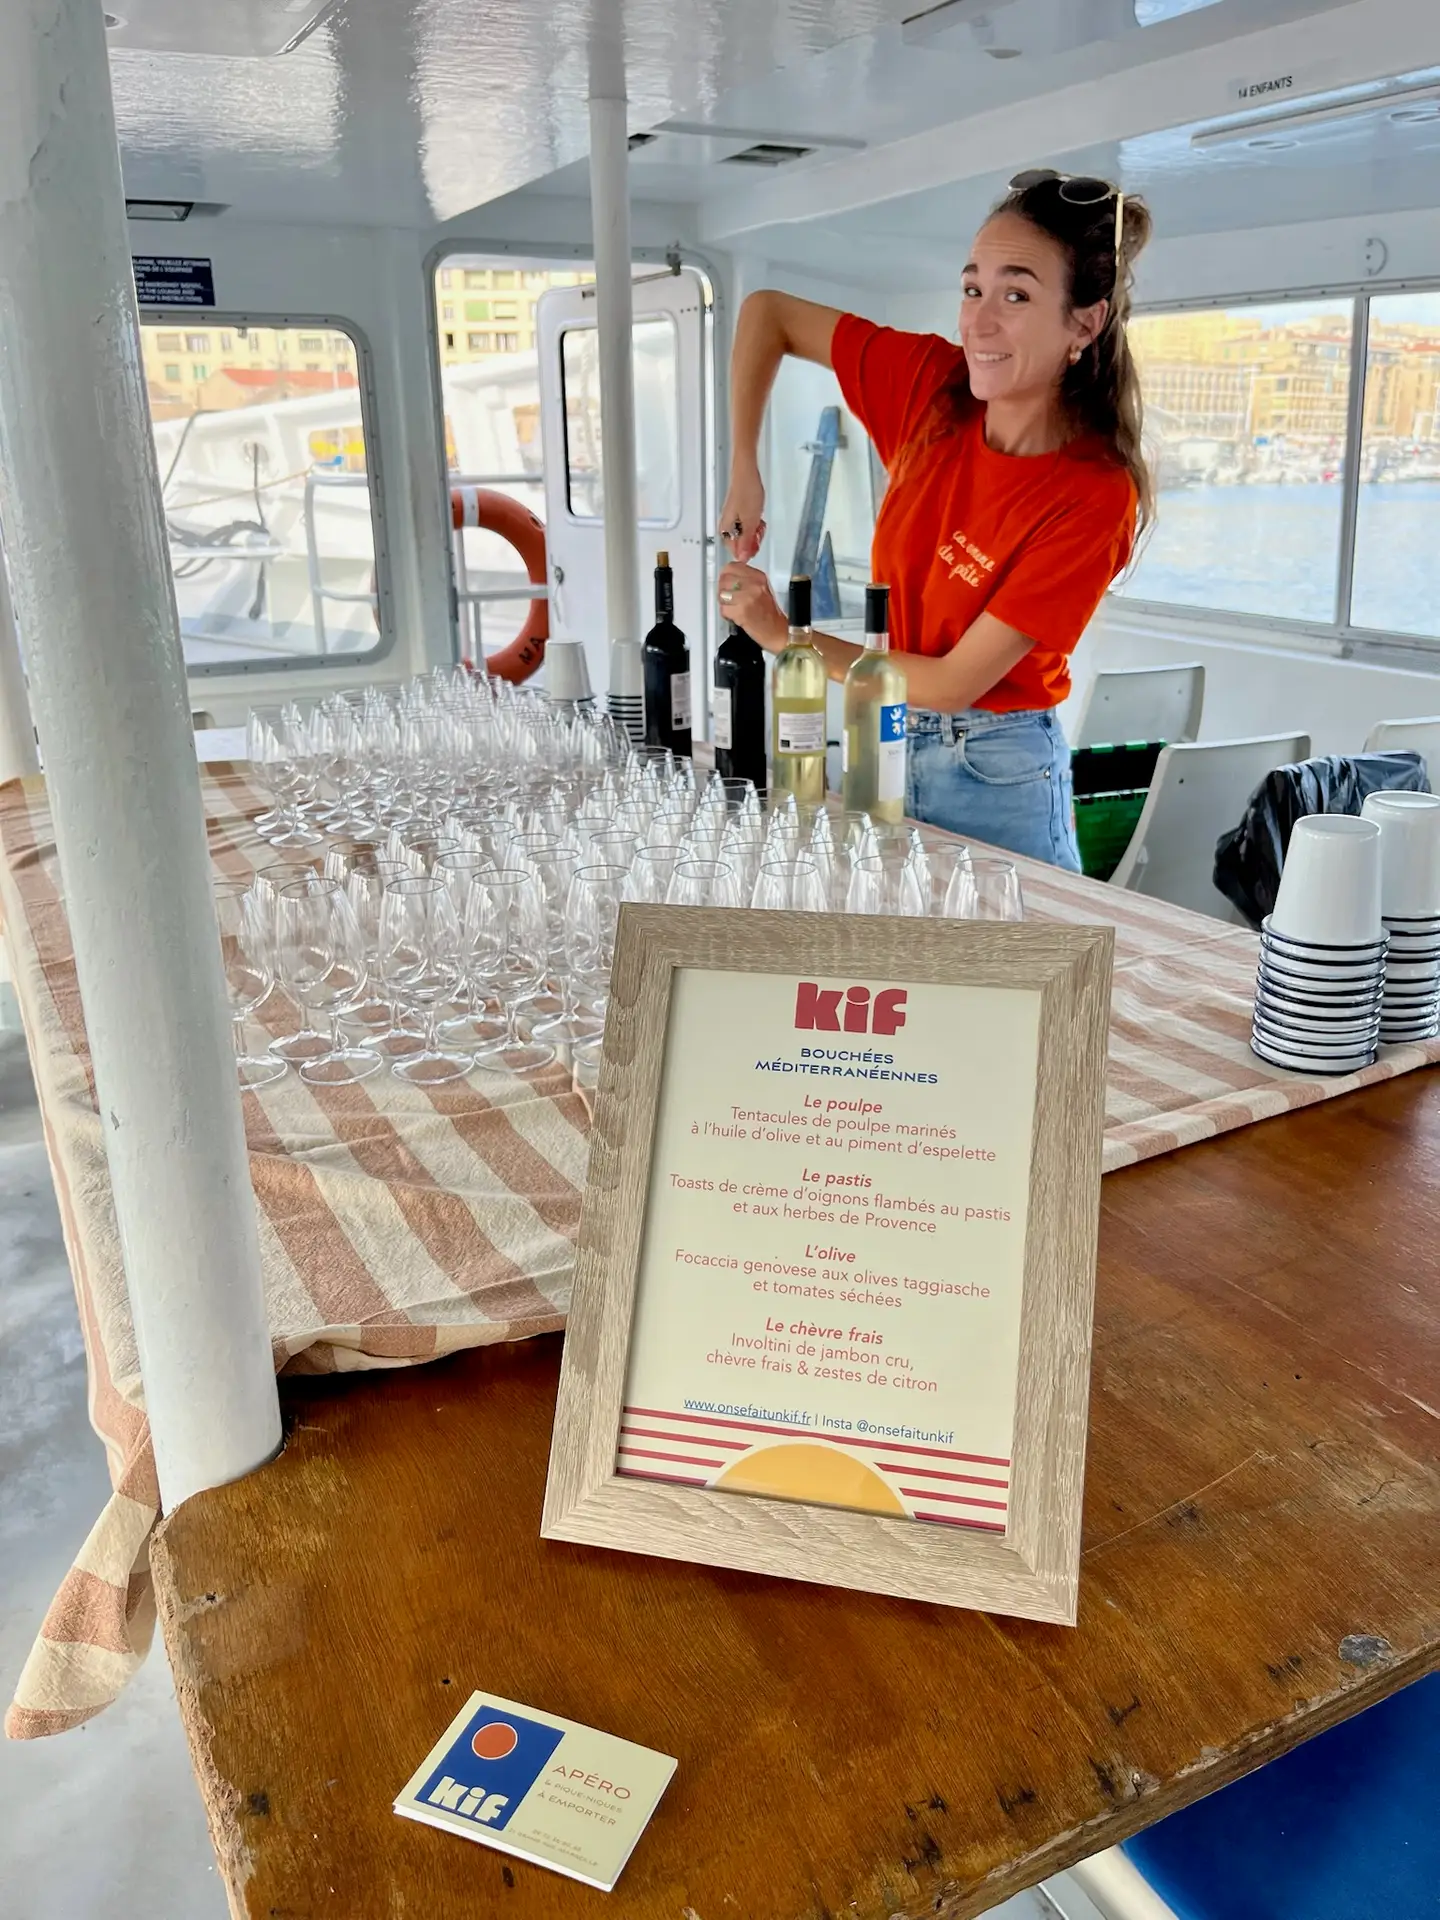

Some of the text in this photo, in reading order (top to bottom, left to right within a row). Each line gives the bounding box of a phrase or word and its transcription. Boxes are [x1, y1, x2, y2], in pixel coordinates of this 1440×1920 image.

[1249, 76, 1293, 98] ENFANTS
[938, 544, 955, 566] du
[755, 1057, 938, 1084] MÉDITERRANÉENNES
[801, 1048, 894, 1064] BOUCHÉES
[804, 1094, 883, 1116] Le poulpe
[731, 1106, 956, 1139] Tentacules de poulpe marinés
[691, 1121, 996, 1162] à l'huile d'olive et au piment d'espelette
[802, 1168, 872, 1188] Le pastis
[670, 1173, 1011, 1222] Toasts de crème d'oignons flambés au pastis
[733, 1202, 936, 1233] et aux herbes de Provence
[805, 1244, 856, 1263] L'olive
[675, 1249, 990, 1298] Focaccia genovese aux olives taggiasche
[753, 1280, 902, 1308] et tomates séchées
[766, 1317, 883, 1345] Le chèvre frais
[732, 1333, 913, 1371] Involtini de jambon cru,
[706, 1349, 937, 1392] chèvre frais & zestes de citron
[683, 1399, 812, 1426] www.onsefaitunkif.fr
[822, 1415, 852, 1430] Insta
[856, 1419, 954, 1444] @onsefaitunkif
[552, 1764, 631, 1800] APÉRO
[549, 1795, 617, 1826] EMPORTER
[554, 1782, 624, 1814] PIQUE-NIQUES
